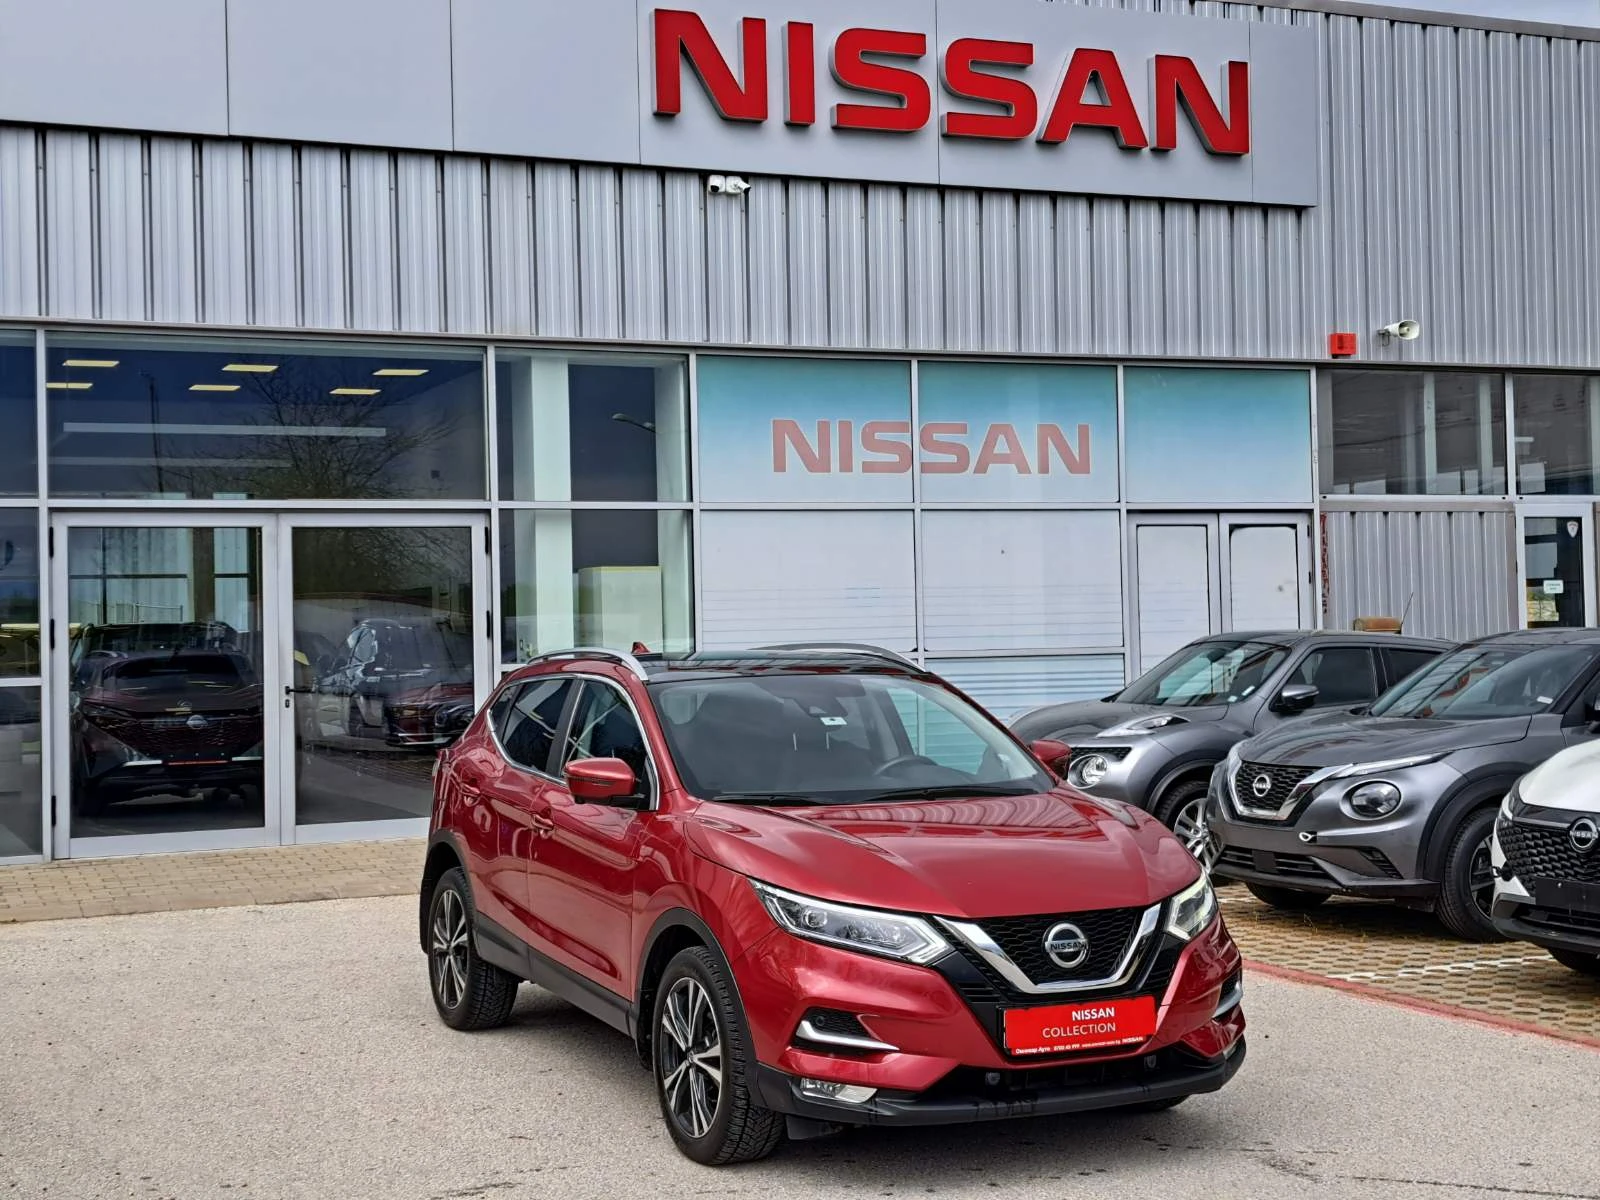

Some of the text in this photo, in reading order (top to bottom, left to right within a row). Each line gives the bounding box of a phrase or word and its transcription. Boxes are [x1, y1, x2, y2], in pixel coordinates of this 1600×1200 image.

[652, 8, 1250, 156] NISSAN
[772, 418, 1092, 475] NISSAN
[1050, 942, 1085, 951] NISSAN
[1071, 1007, 1115, 1021] NISSAN
[1042, 1022, 1116, 1038] COLLECTION
